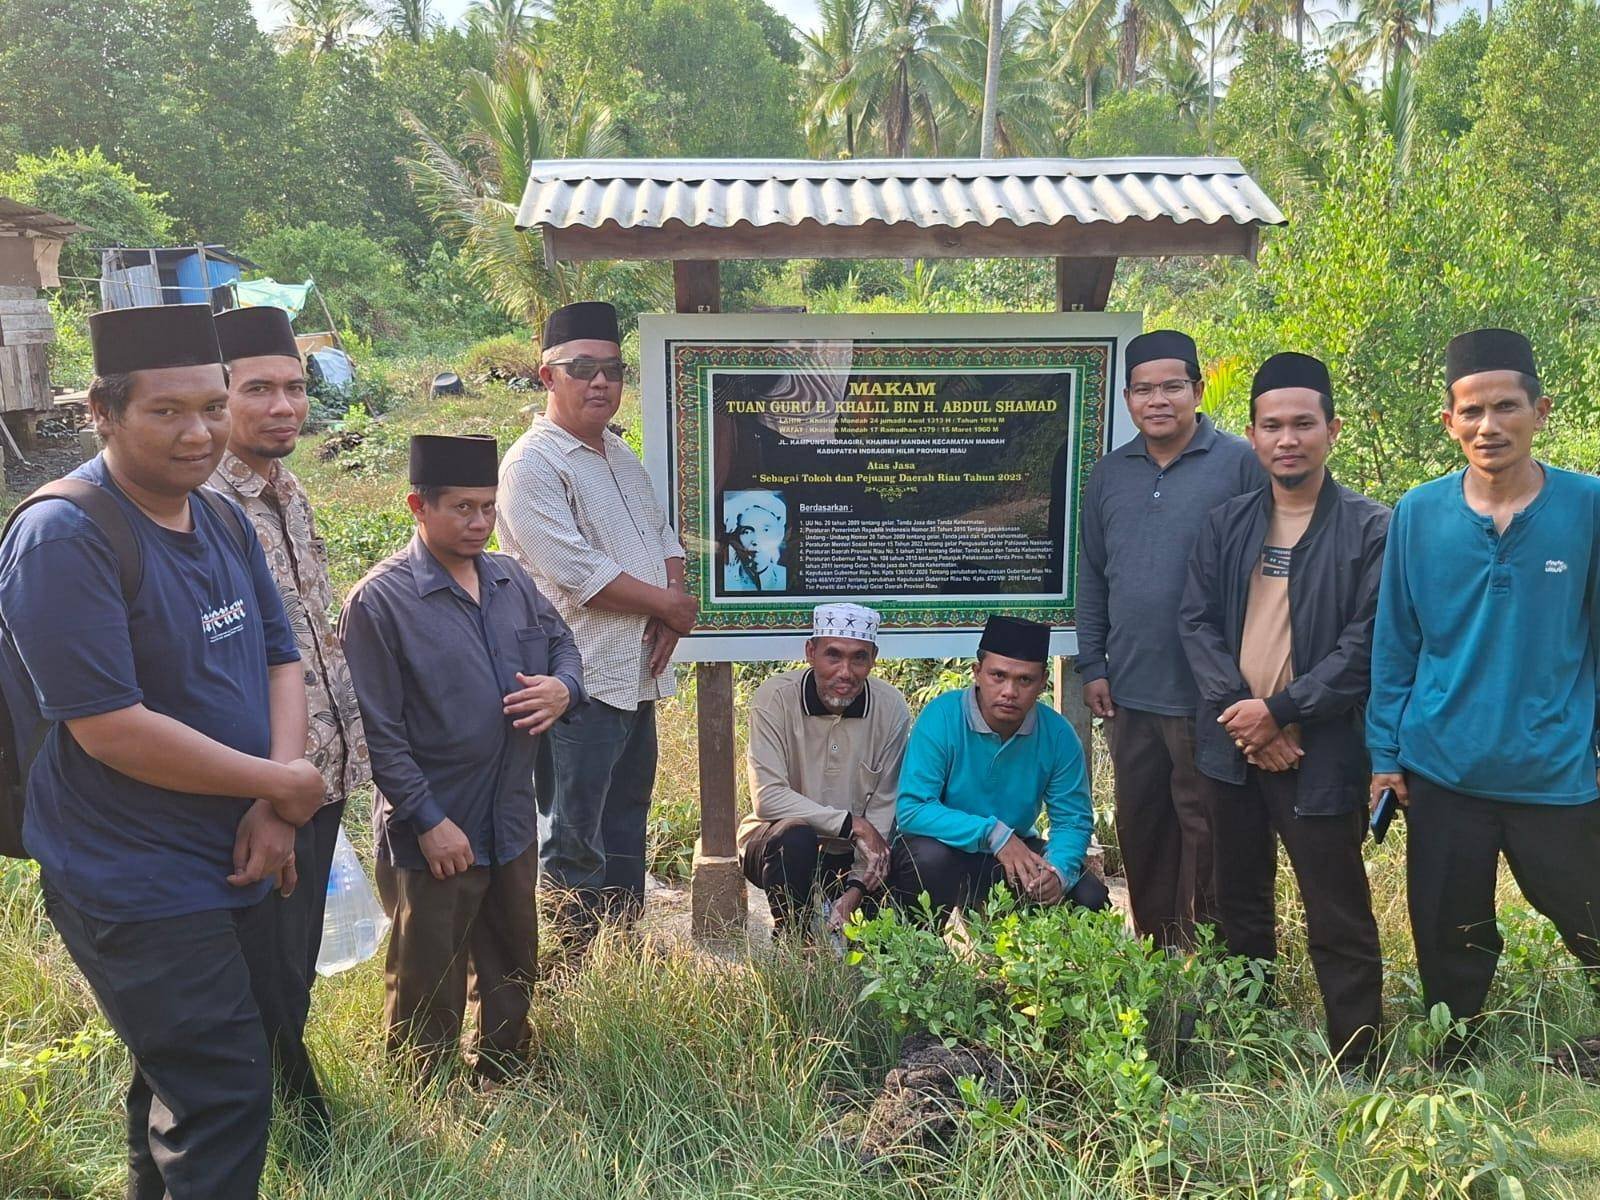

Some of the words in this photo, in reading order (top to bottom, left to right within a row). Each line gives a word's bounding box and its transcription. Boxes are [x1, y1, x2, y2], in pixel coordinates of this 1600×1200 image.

[848, 382, 936, 396] MAKAM
[726, 401, 766, 413] TUAN
[770, 401, 812, 413] GURU
[816, 401, 830, 413] H.
[835, 400, 890, 413] KHALIL
[894, 400, 920, 413] BIN
[924, 400, 938, 413] H.
[943, 400, 992, 413] ABDUL
[995, 400, 1058, 412] SHAMAD
[867, 461, 890, 470] Atas
[892, 461, 916, 470] Jasa
[759, 474, 799, 484] Sebagai
[801, 474, 832, 482] Tokoh
[835, 474, 854, 482] dan
[856, 474, 896, 484] Pejuang
[899, 474, 934, 482] Daerah
[937, 473, 961, 482] Riau
[963, 473, 994, 482] Tahun
[998, 473, 1022, 481] 2023
[800, 504, 849, 512] Berdasarkan
